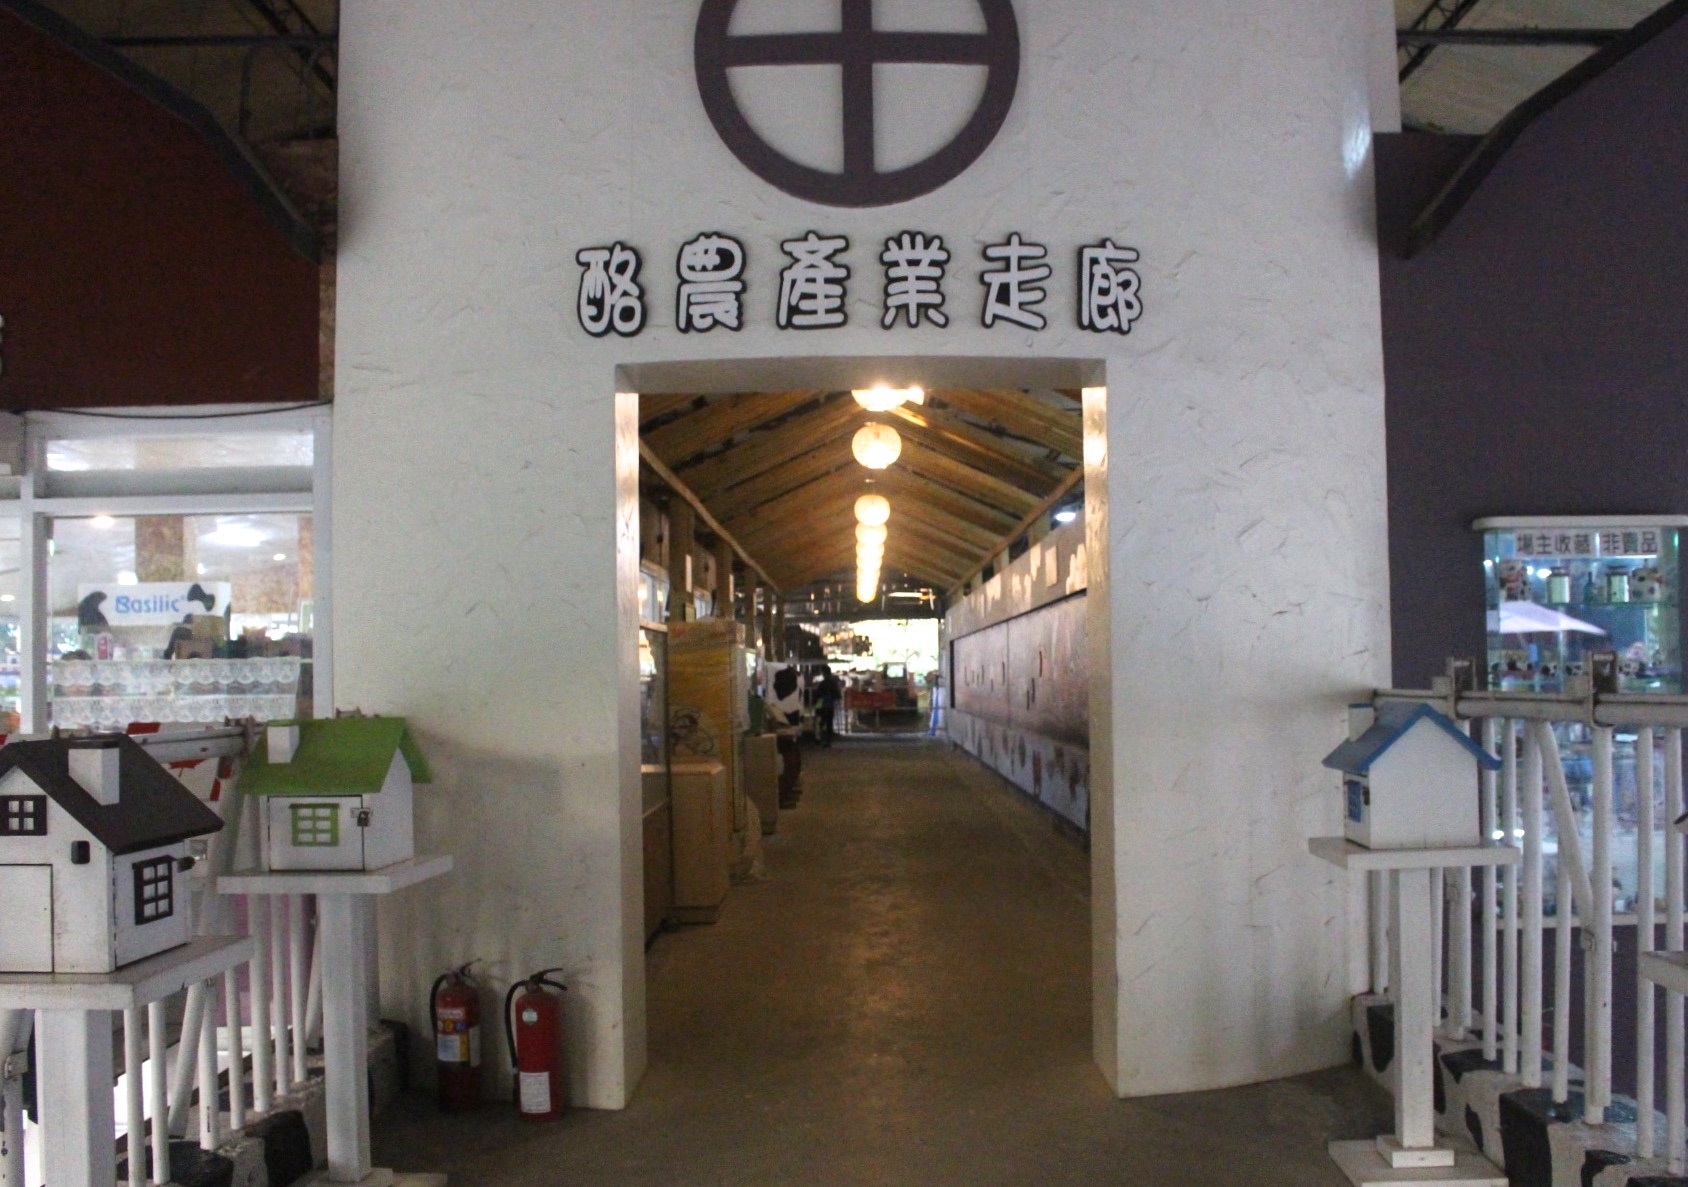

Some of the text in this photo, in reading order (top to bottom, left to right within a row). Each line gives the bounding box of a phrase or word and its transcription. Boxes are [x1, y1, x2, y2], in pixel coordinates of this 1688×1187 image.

[576, 231, 1142, 336] 酪農產業走廊
[115, 595, 179, 613] Basilic
